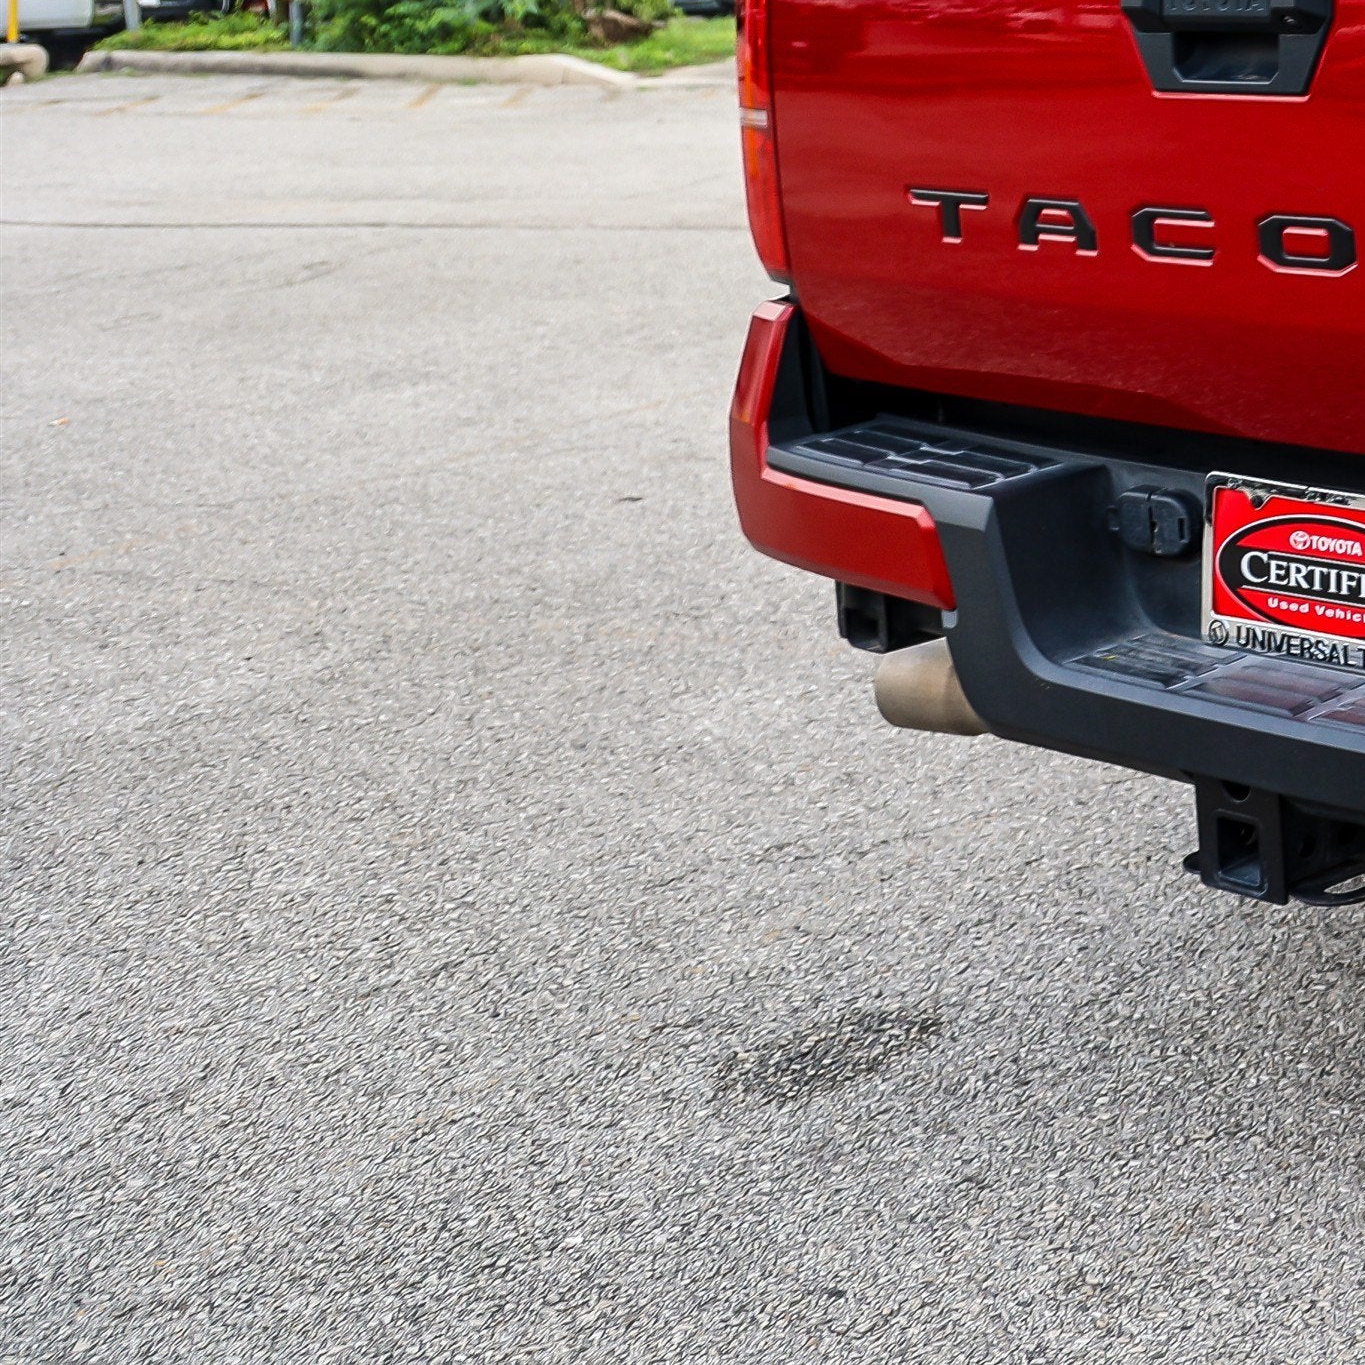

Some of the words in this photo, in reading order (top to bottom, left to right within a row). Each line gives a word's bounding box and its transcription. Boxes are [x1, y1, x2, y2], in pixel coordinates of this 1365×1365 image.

[1310, 535, 1363, 557] TOYOTA
[1267, 597, 1310, 614] Used
[1236, 624, 1357, 667] UNIVERSAL
